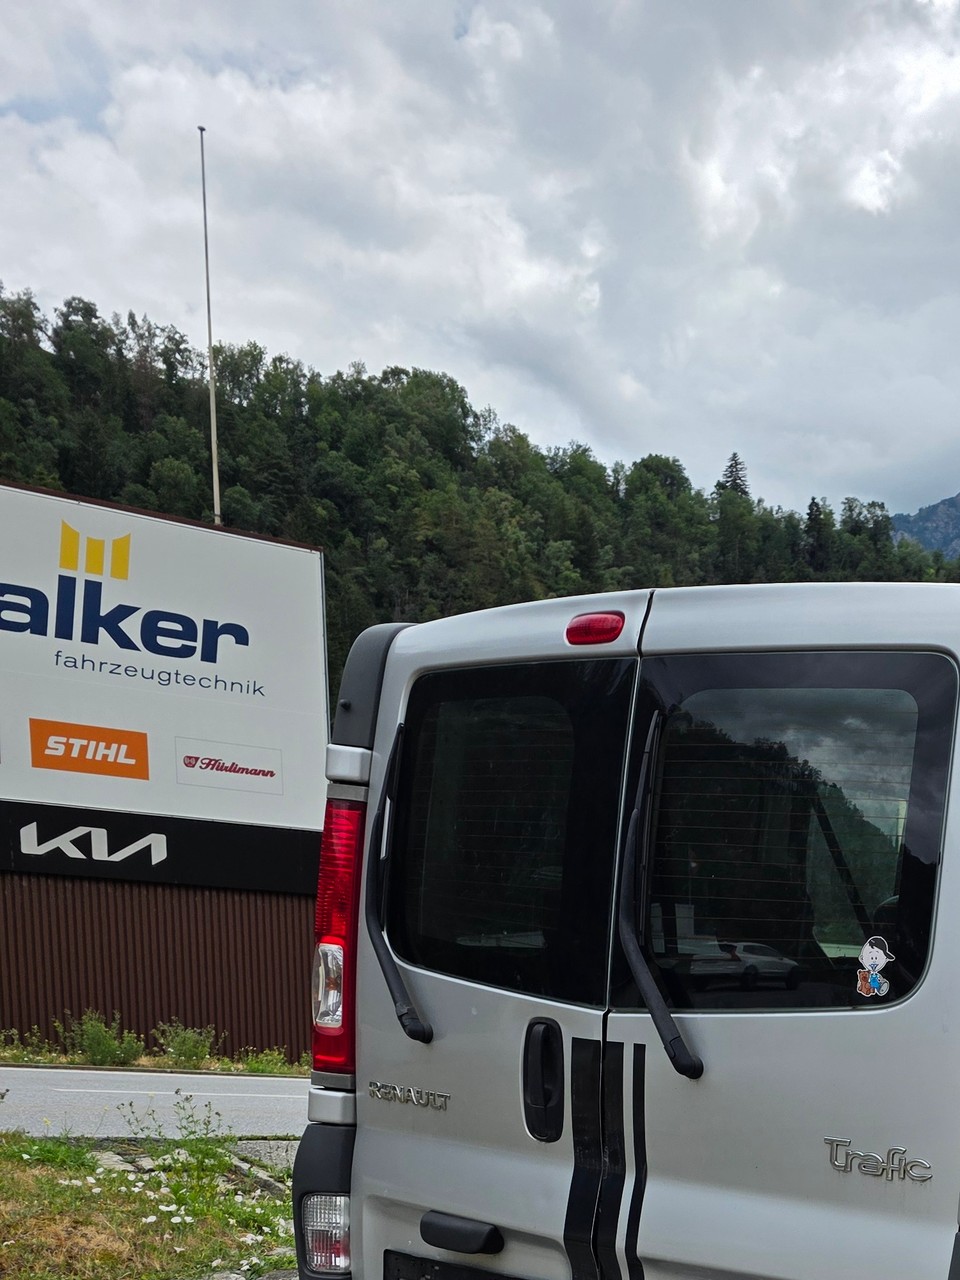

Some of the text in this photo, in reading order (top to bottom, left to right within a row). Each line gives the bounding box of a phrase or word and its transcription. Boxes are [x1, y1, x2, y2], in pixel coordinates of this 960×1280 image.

[55, 650, 266, 697] fahrzeugtechnik
[44, 735, 137, 766] STIHL
[368, 1081, 451, 1111] RENAULT
[824, 1136, 933, 1182] Trafic
